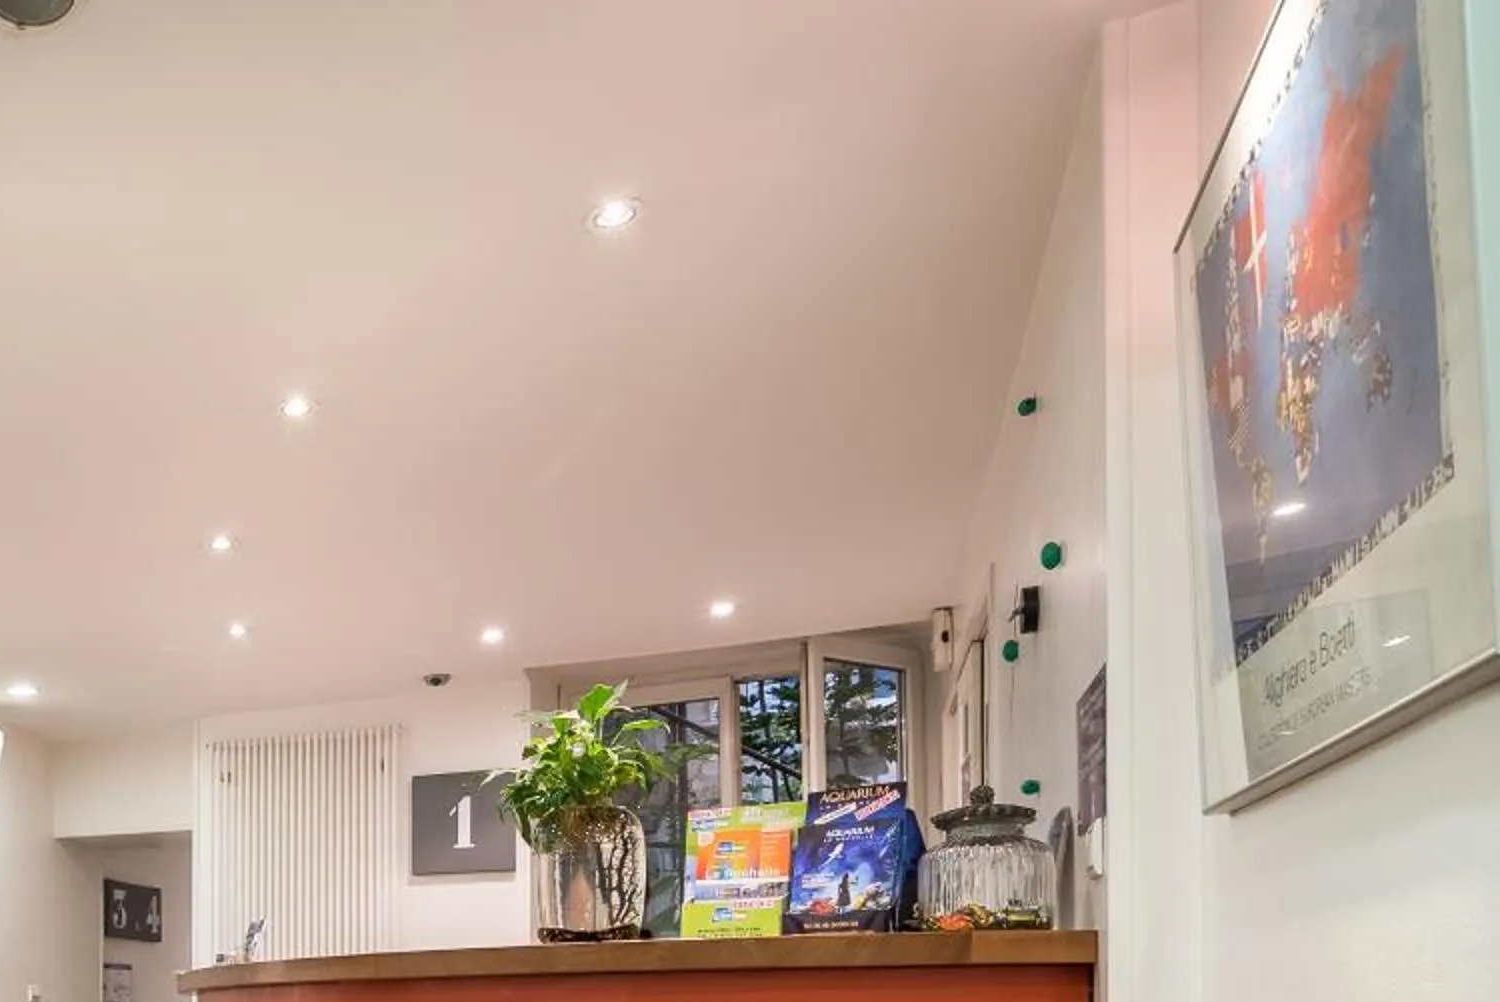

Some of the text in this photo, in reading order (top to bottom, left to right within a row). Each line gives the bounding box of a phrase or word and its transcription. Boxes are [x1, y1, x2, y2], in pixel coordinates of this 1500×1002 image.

[820, 785, 890, 804] AQUARIUM
[448, 795, 476, 849] 1
[112, 889, 160, 934] 3 4
